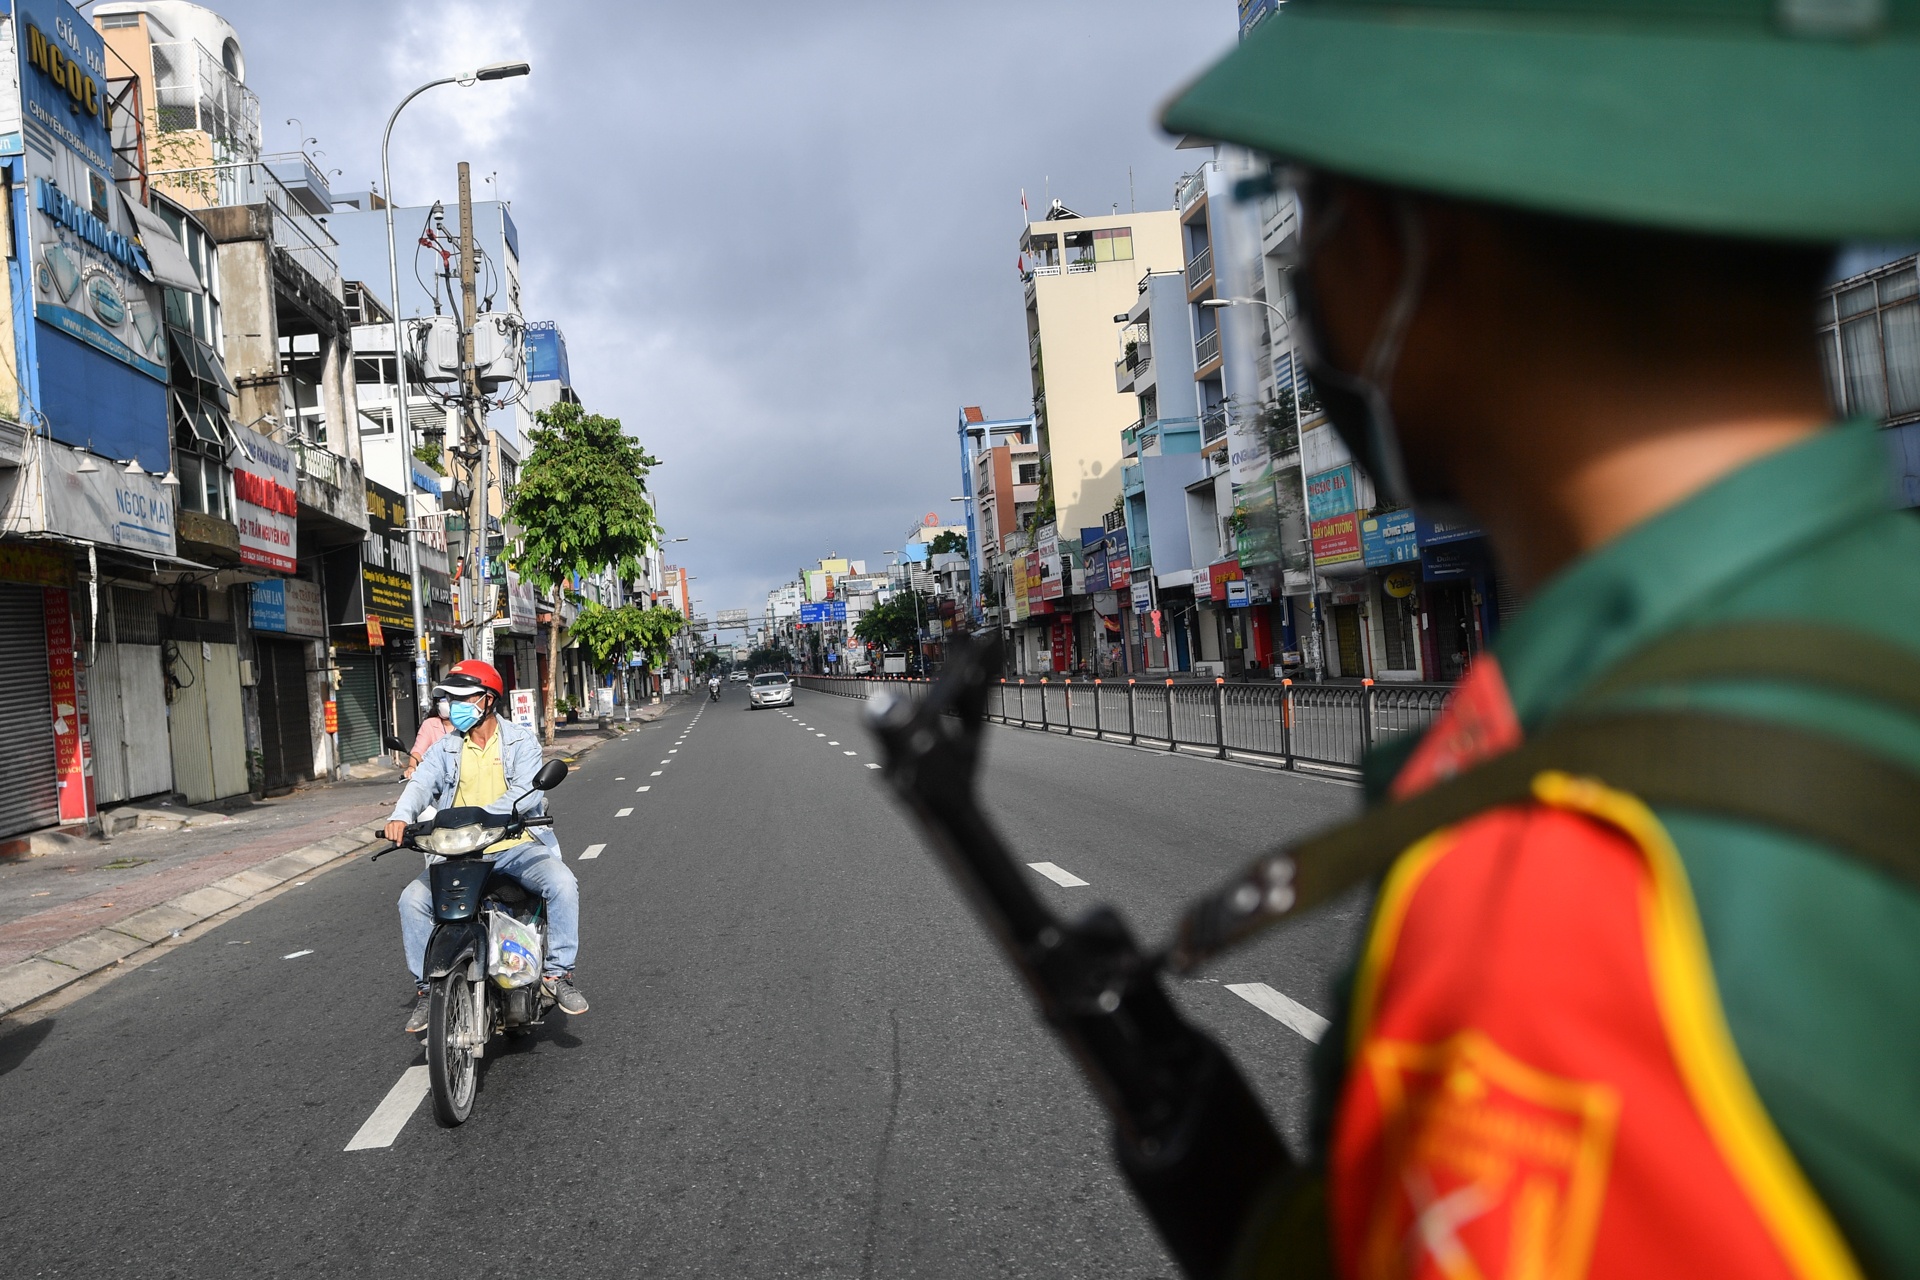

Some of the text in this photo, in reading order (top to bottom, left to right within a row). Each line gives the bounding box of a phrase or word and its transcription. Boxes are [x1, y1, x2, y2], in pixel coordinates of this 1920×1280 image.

[26, 23, 98, 116] NGỌC
[115, 488, 170, 525] NGỌC MAI
[1389, 578, 1411, 589] Yale
